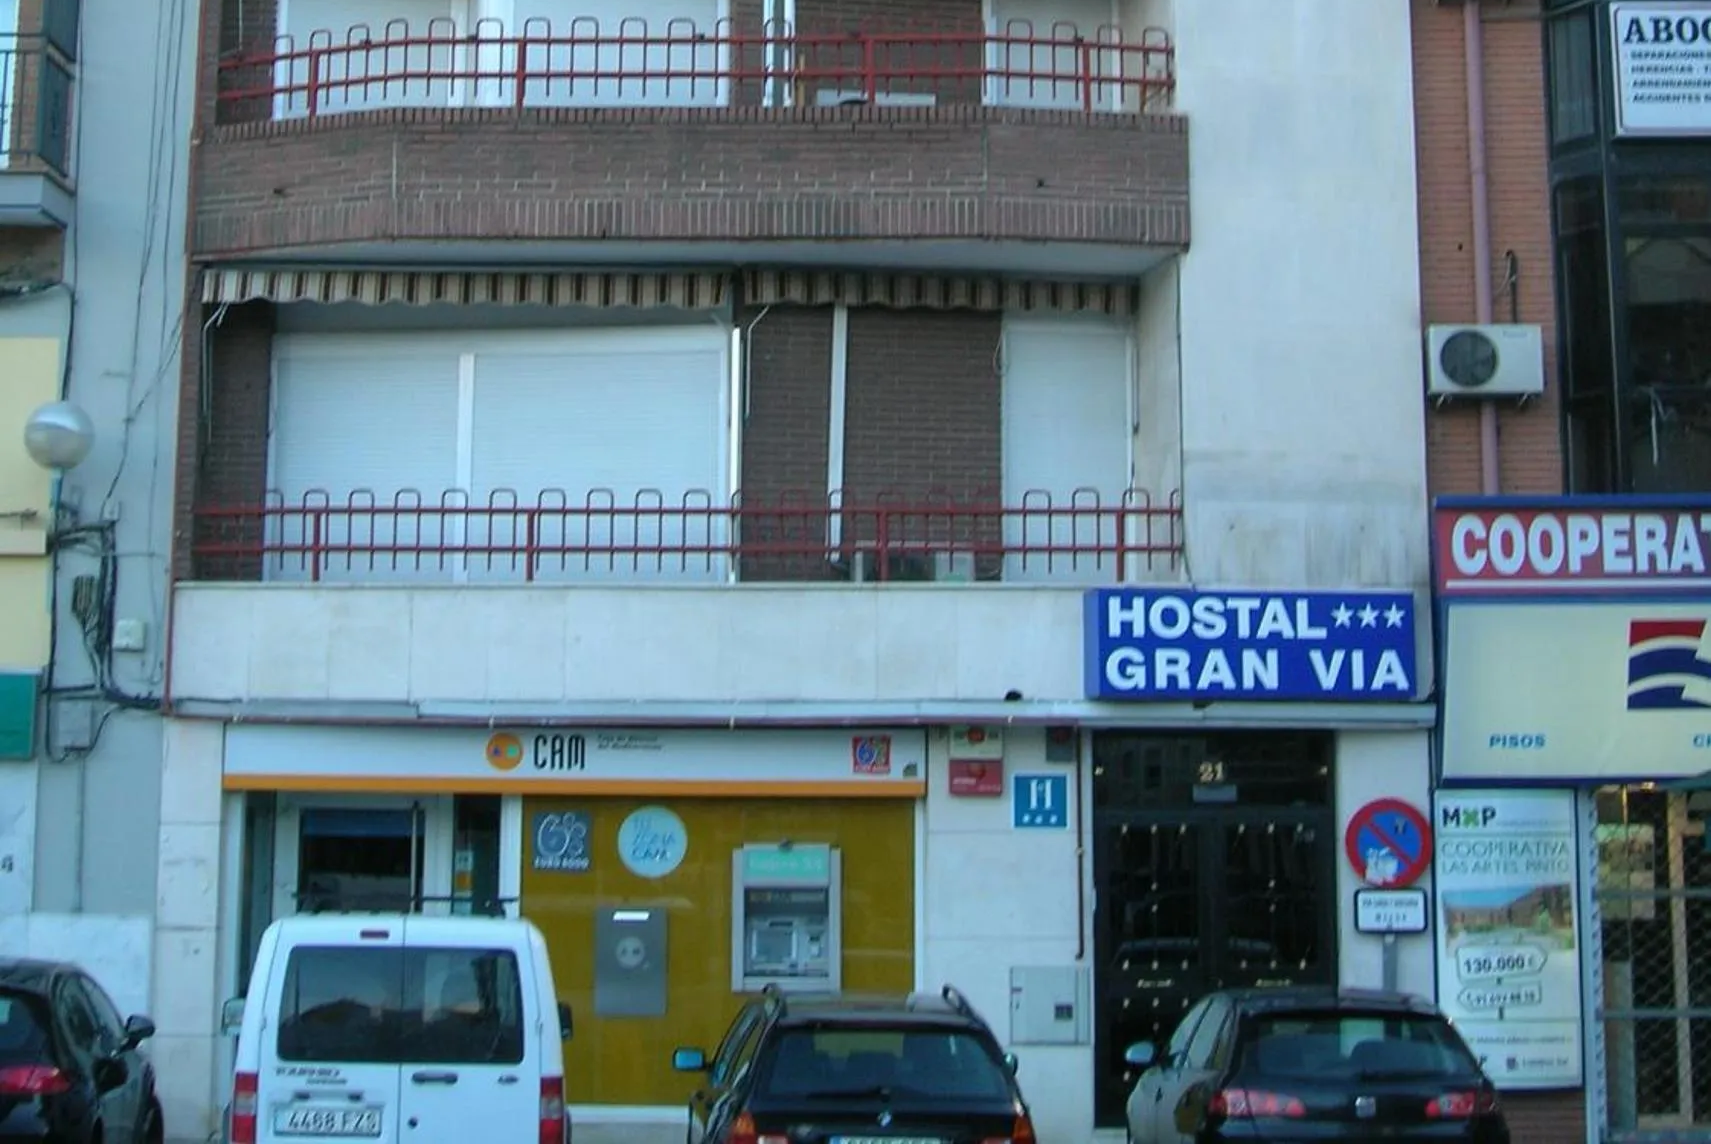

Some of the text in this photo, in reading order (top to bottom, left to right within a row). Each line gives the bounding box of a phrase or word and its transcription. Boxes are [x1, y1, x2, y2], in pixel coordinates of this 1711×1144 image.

[1107, 596, 1327, 639] HOSTAL
[1105, 647, 1409, 690] GRAN VIA
[533, 733, 586, 770] CAM
[1489, 734, 1546, 748] PISOS
